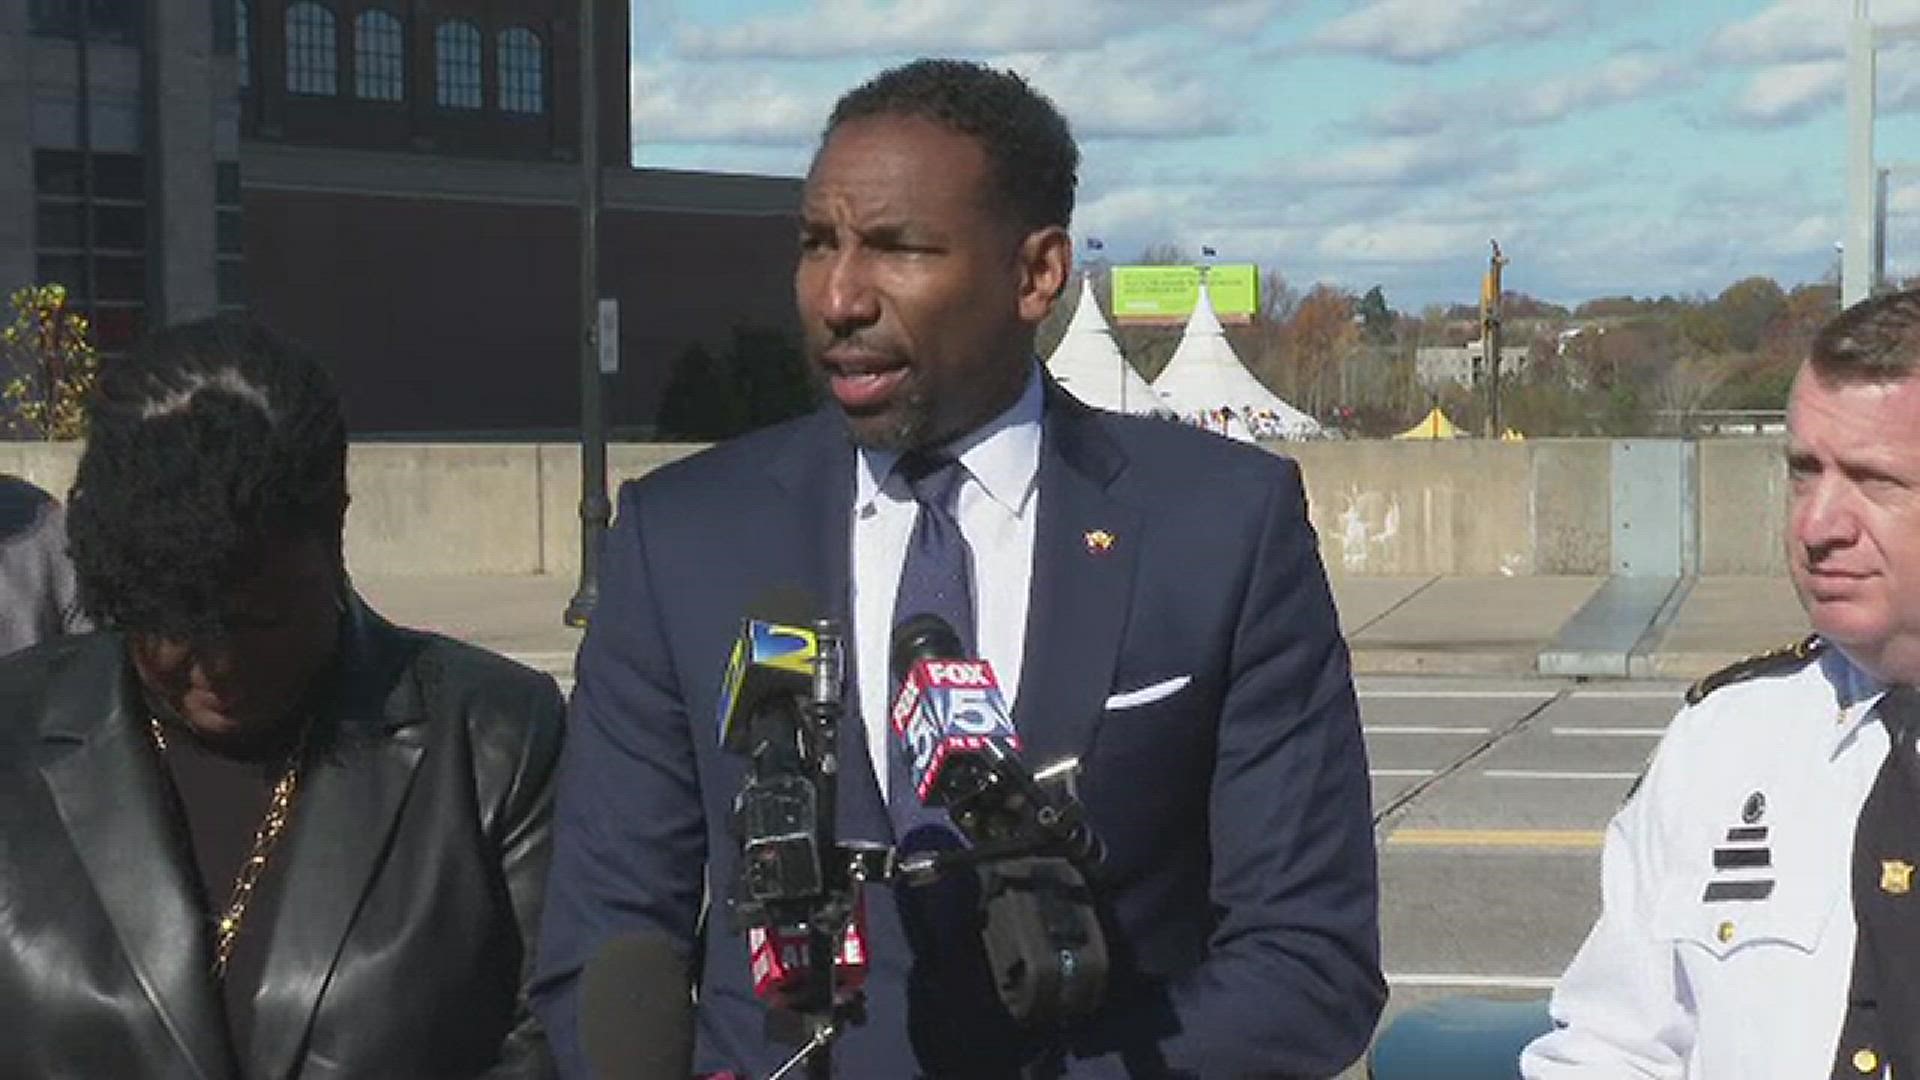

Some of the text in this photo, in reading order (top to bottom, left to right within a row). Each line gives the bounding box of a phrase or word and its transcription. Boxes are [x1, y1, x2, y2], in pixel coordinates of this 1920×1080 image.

[757, 624, 817, 675] 2
[927, 663, 991, 685] FOX
[948, 688, 996, 734] 5
